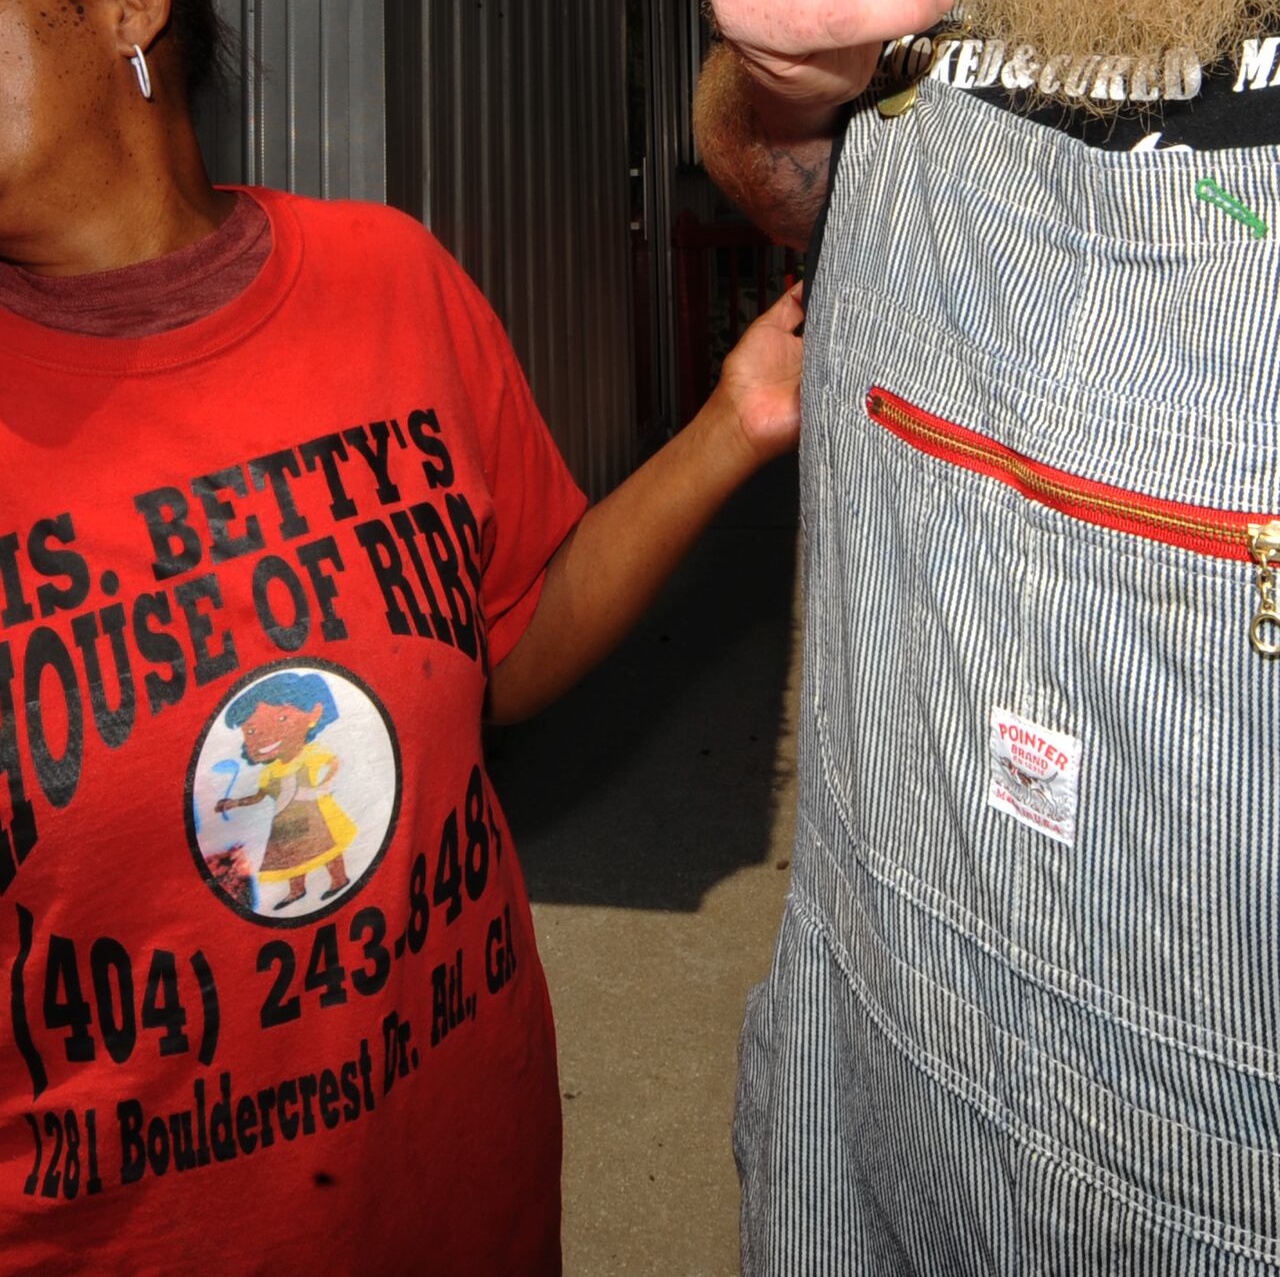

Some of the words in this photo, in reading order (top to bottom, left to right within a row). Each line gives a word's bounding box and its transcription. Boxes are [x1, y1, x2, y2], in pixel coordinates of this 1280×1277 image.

[135, 408, 456, 582] BETTY'S
[251, 536, 349, 652] OF
[360, 493, 488, 677] RIBS
[999, 723, 1069, 771] POINTER
[1011, 744, 1049, 770] BRAND
[11, 902, 219, 1102] (404)
[23, 1109, 102, 1202] 1281
[115, 1039, 376, 1186] Bouldercrest
